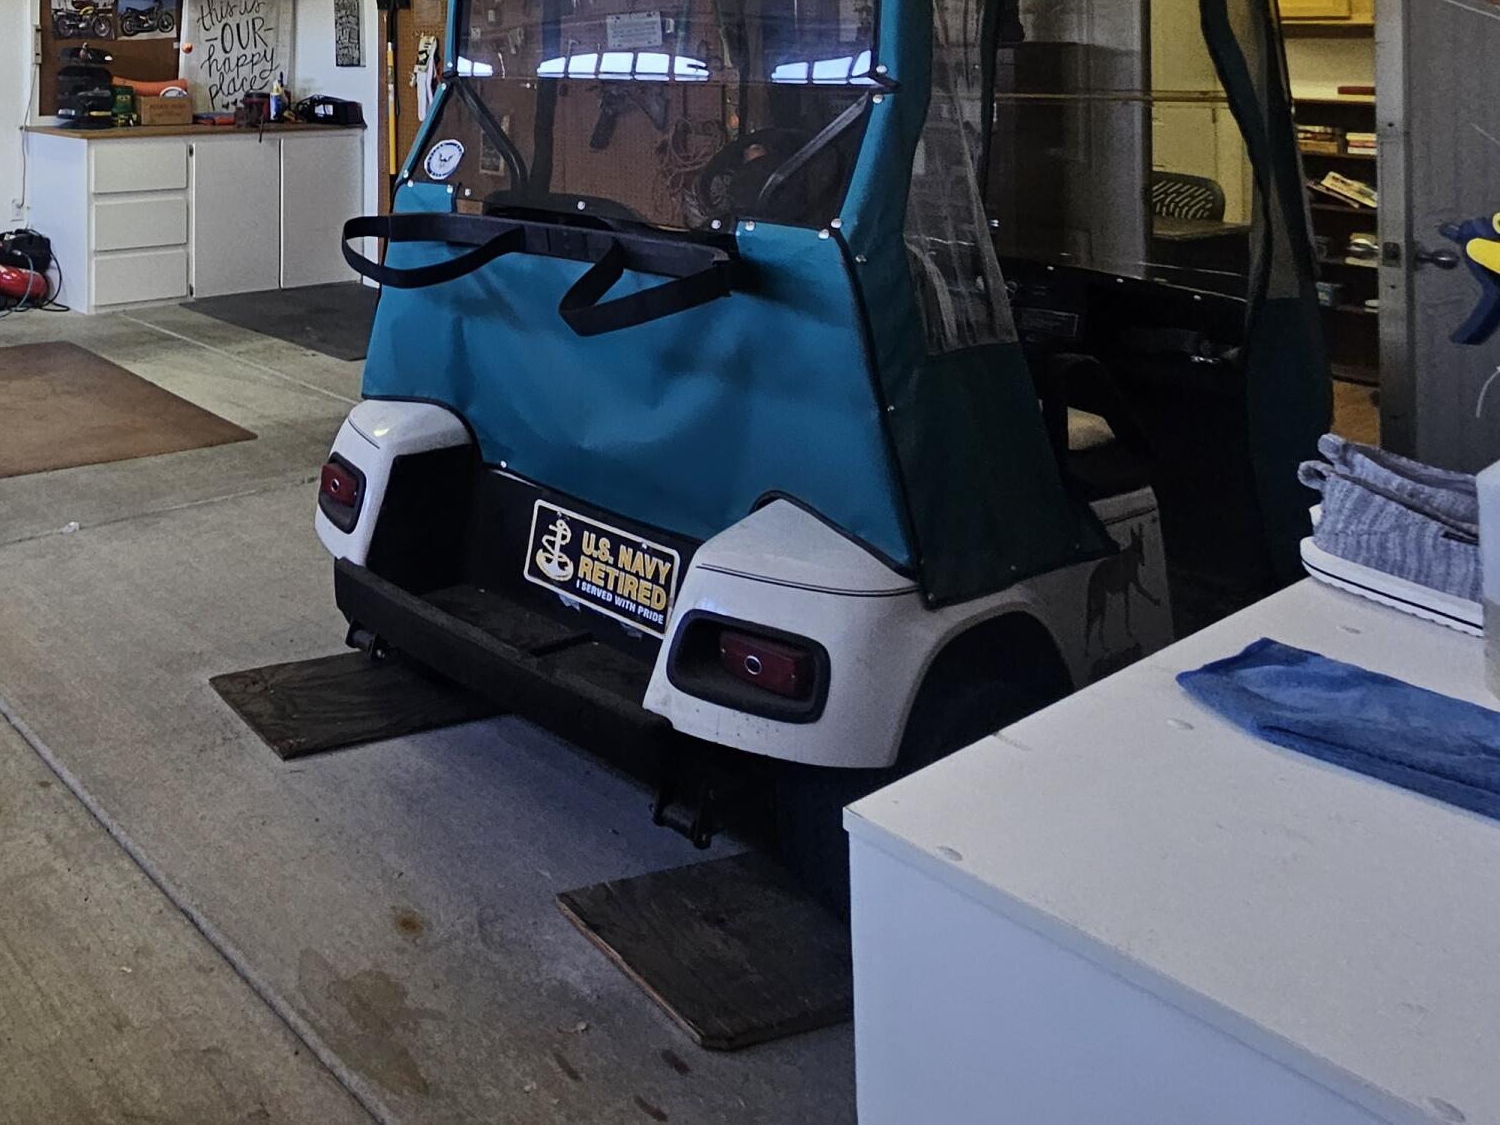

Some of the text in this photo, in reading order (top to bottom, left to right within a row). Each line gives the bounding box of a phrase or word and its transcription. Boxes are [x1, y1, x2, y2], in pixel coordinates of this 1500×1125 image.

[200, 44, 280, 80] happy
[208, 71, 270, 111] place
[582, 530, 672, 585] U.S. NAVY
[575, 579, 664, 625] I SERVED WITH PRIDE
[578, 555, 667, 611] RETIRED
